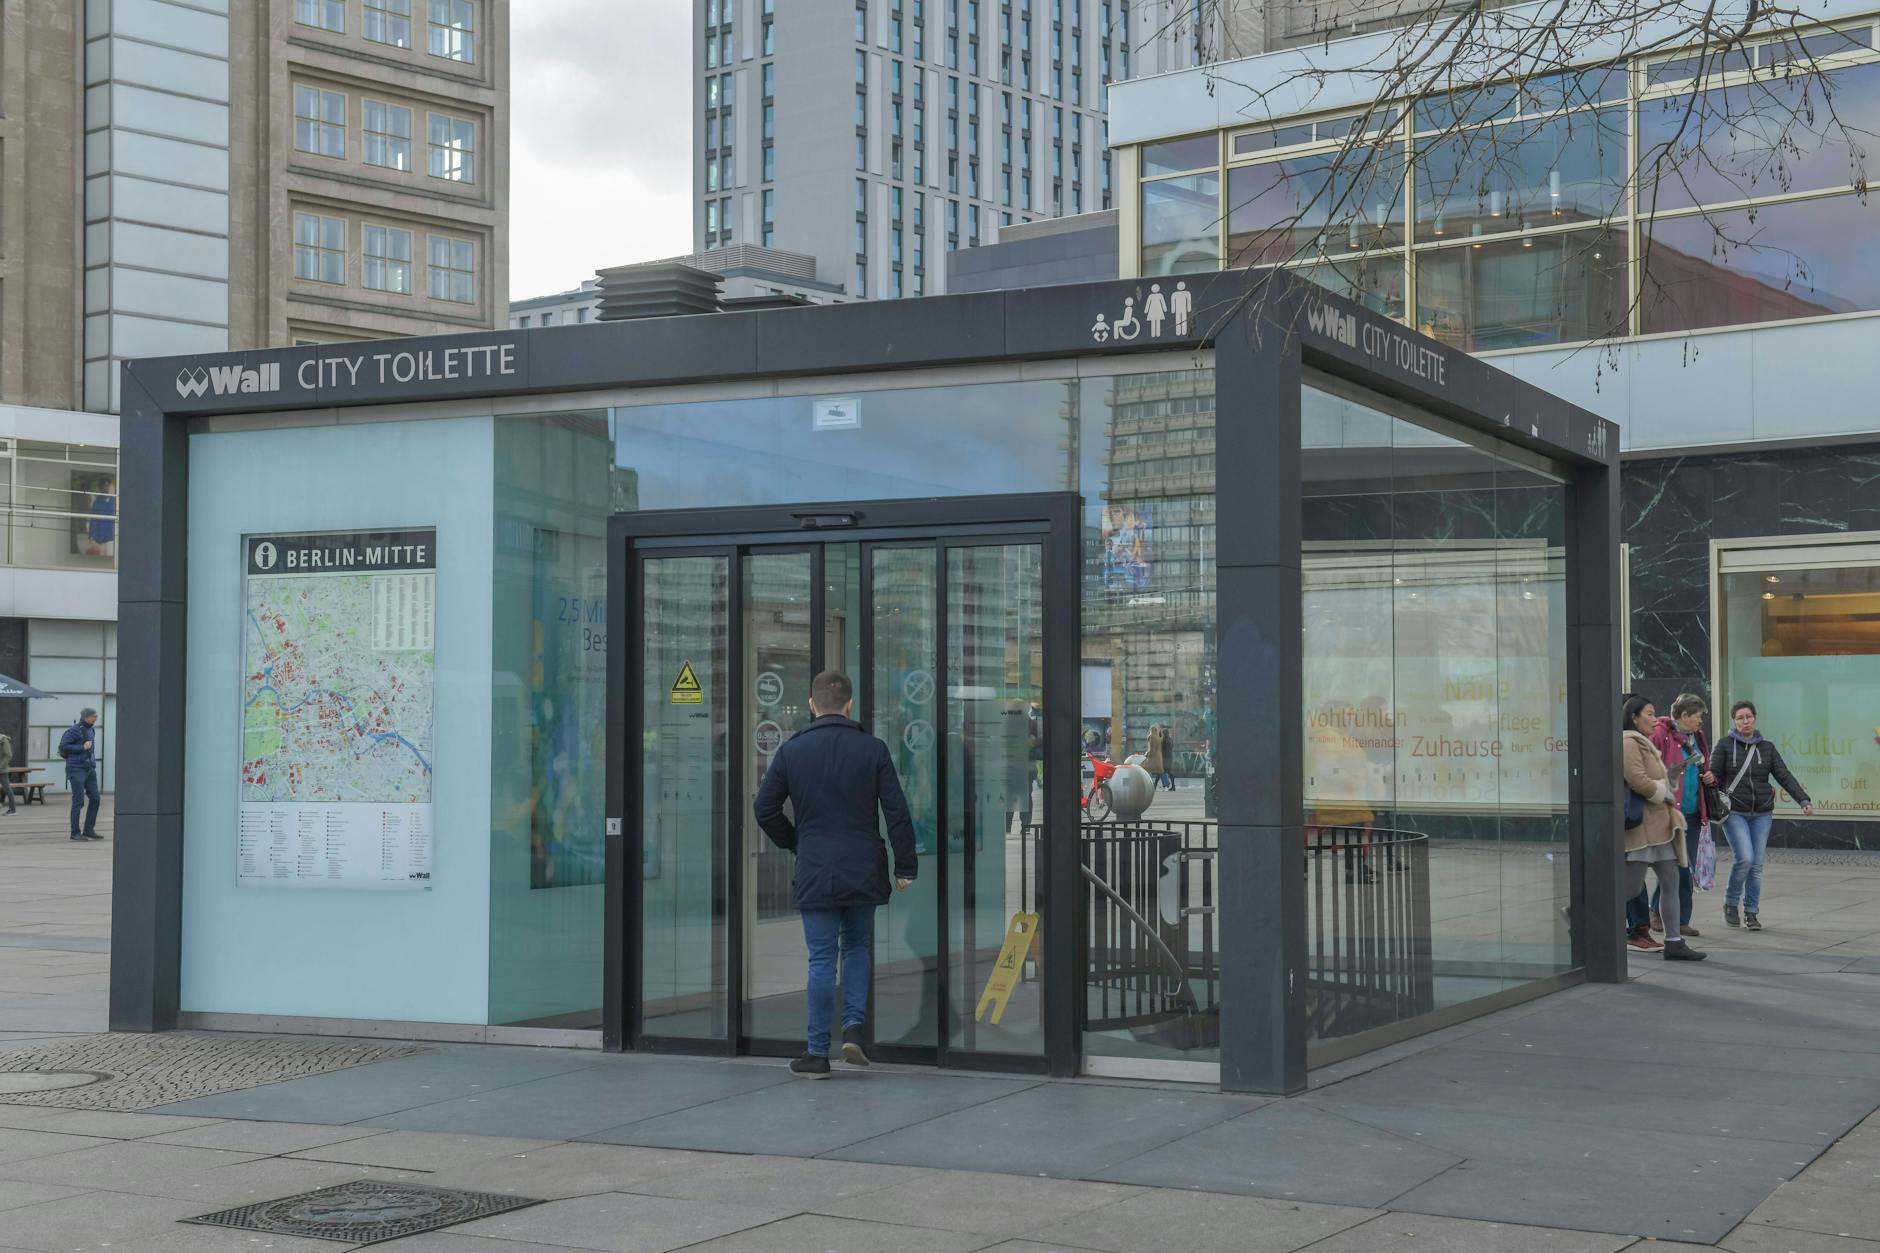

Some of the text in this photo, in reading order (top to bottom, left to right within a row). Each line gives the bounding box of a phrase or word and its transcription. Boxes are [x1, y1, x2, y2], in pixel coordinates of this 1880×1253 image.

[1324, 304, 1357, 348] Wall
[1363, 322, 1390, 361] CITY
[209, 344, 516, 395] Wall CITY TOILETTE
[287, 545, 427, 568] BERLIN-MITTE
[1342, 735, 1404, 749] Miteinander
[1412, 735, 1503, 758] Zuhause
[1781, 732, 1857, 756] Kultur
[1840, 777, 1869, 791] Duft
